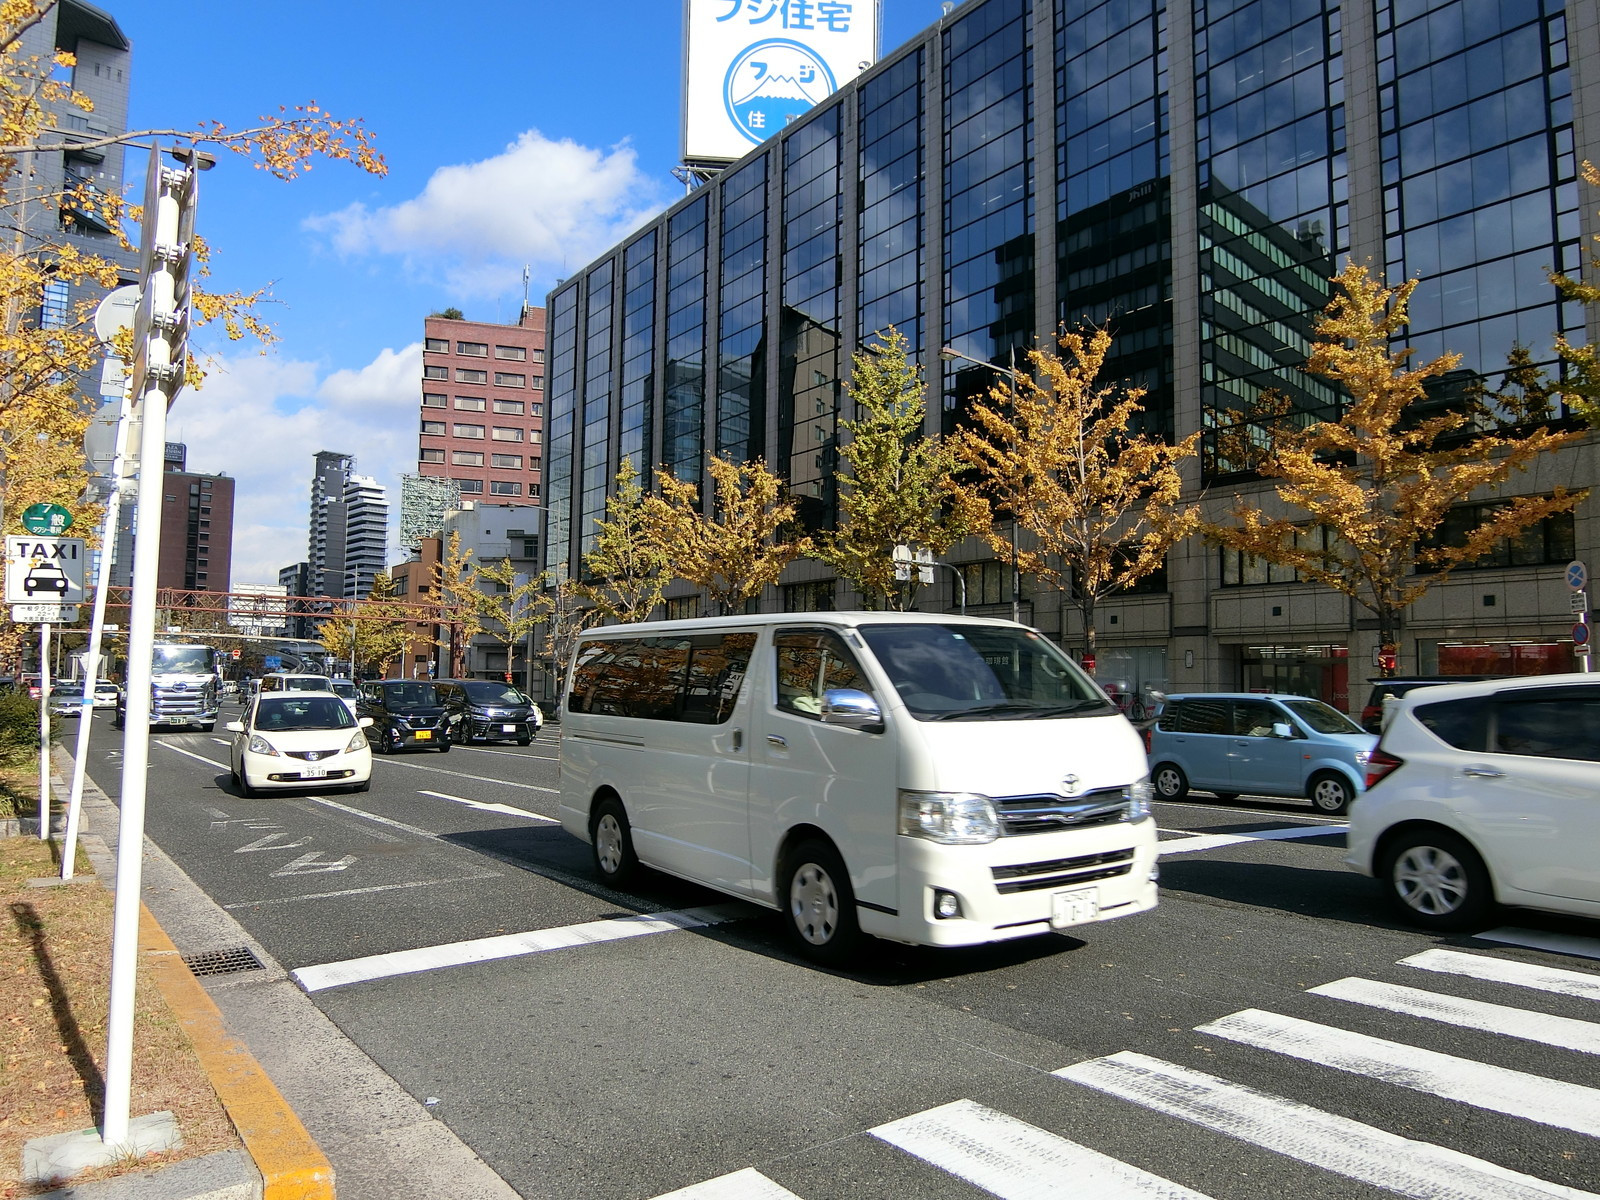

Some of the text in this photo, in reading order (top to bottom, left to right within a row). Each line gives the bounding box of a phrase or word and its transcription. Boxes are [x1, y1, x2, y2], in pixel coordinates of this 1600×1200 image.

[715, 0, 852, 33] フジ住宅
[42, 503, 52, 513] 7
[29, 513, 65, 526] 一般
[17, 543, 77, 559] TAXI
